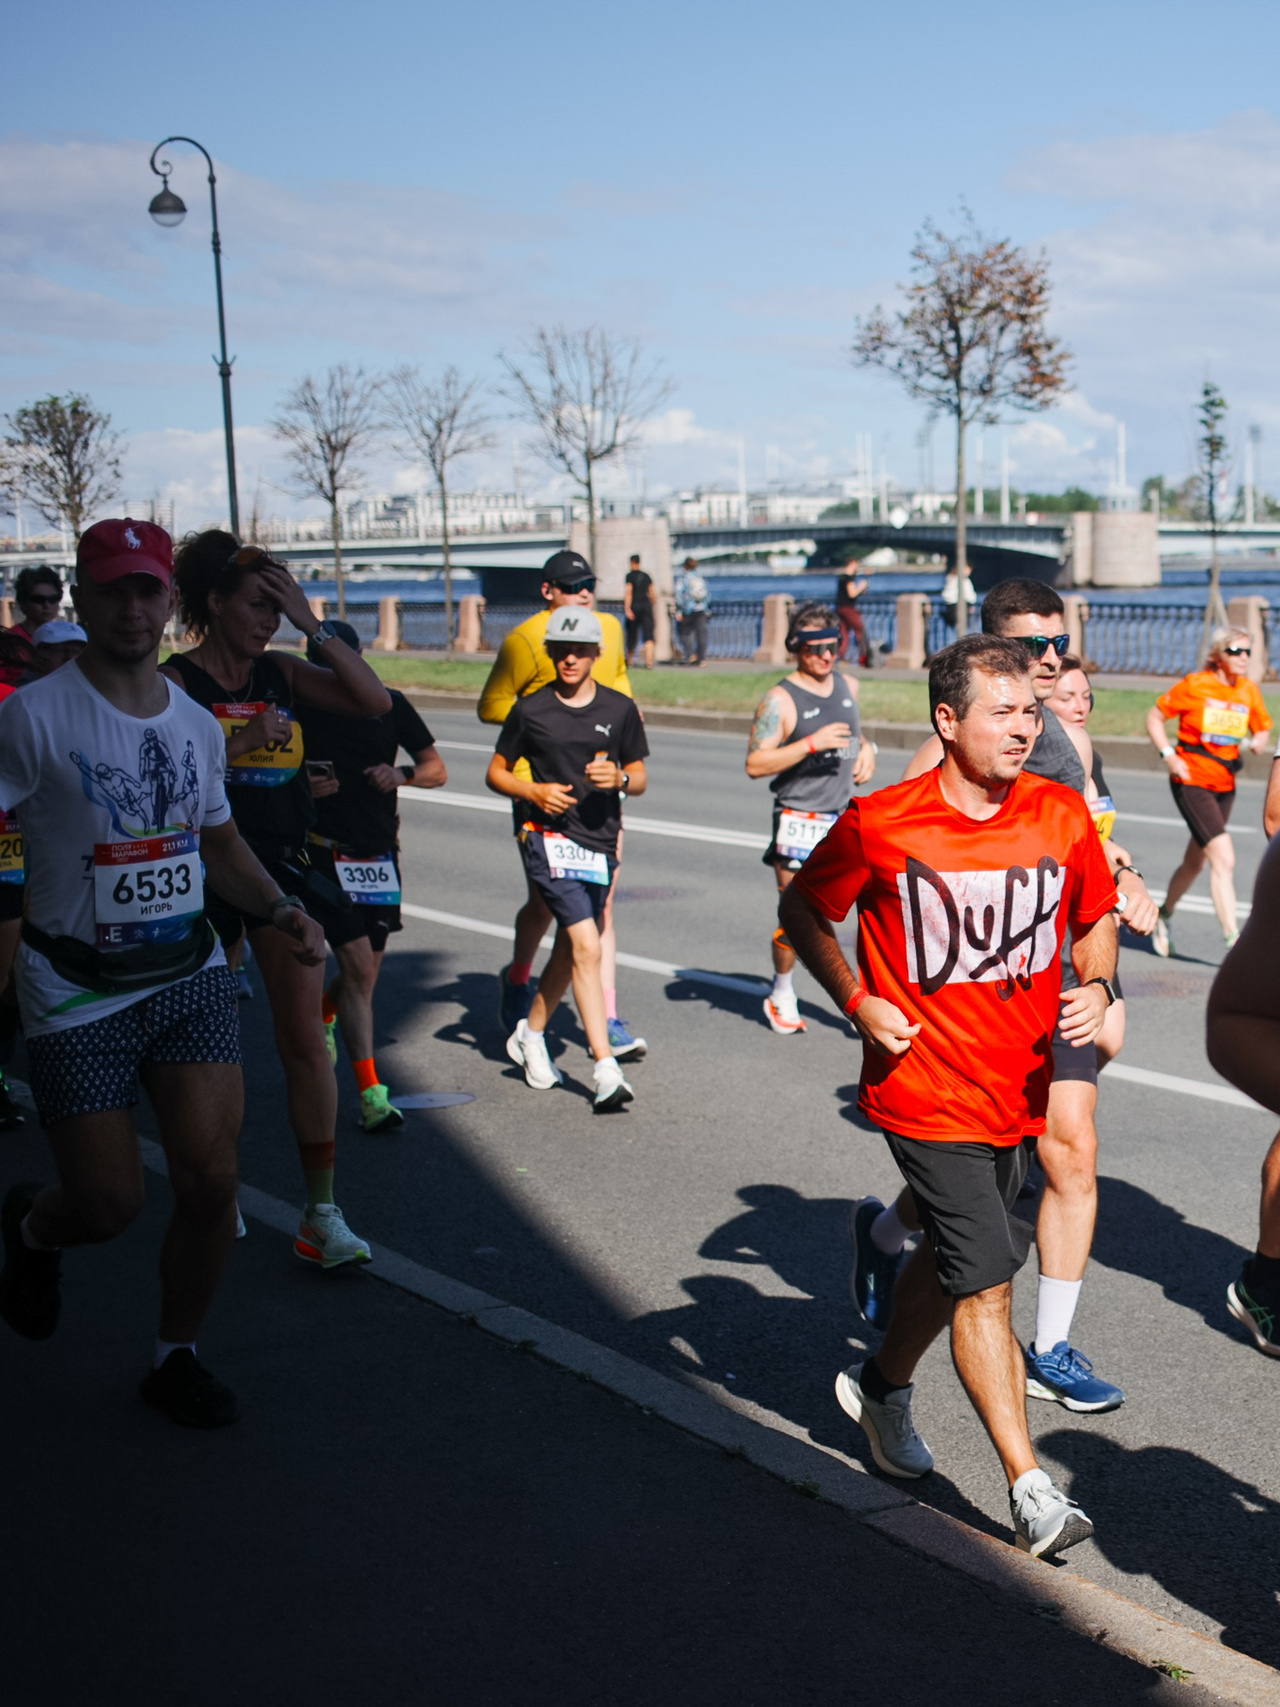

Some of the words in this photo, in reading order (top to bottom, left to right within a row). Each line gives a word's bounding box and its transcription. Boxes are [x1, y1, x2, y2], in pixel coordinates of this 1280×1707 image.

[343, 866, 389, 883] 3306
[112, 863, 191, 905] 6533
[140, 902, 173, 916] ИГОРЬ
[109, 926, 123, 943] E
[907, 855, 1060, 1002] Duff
